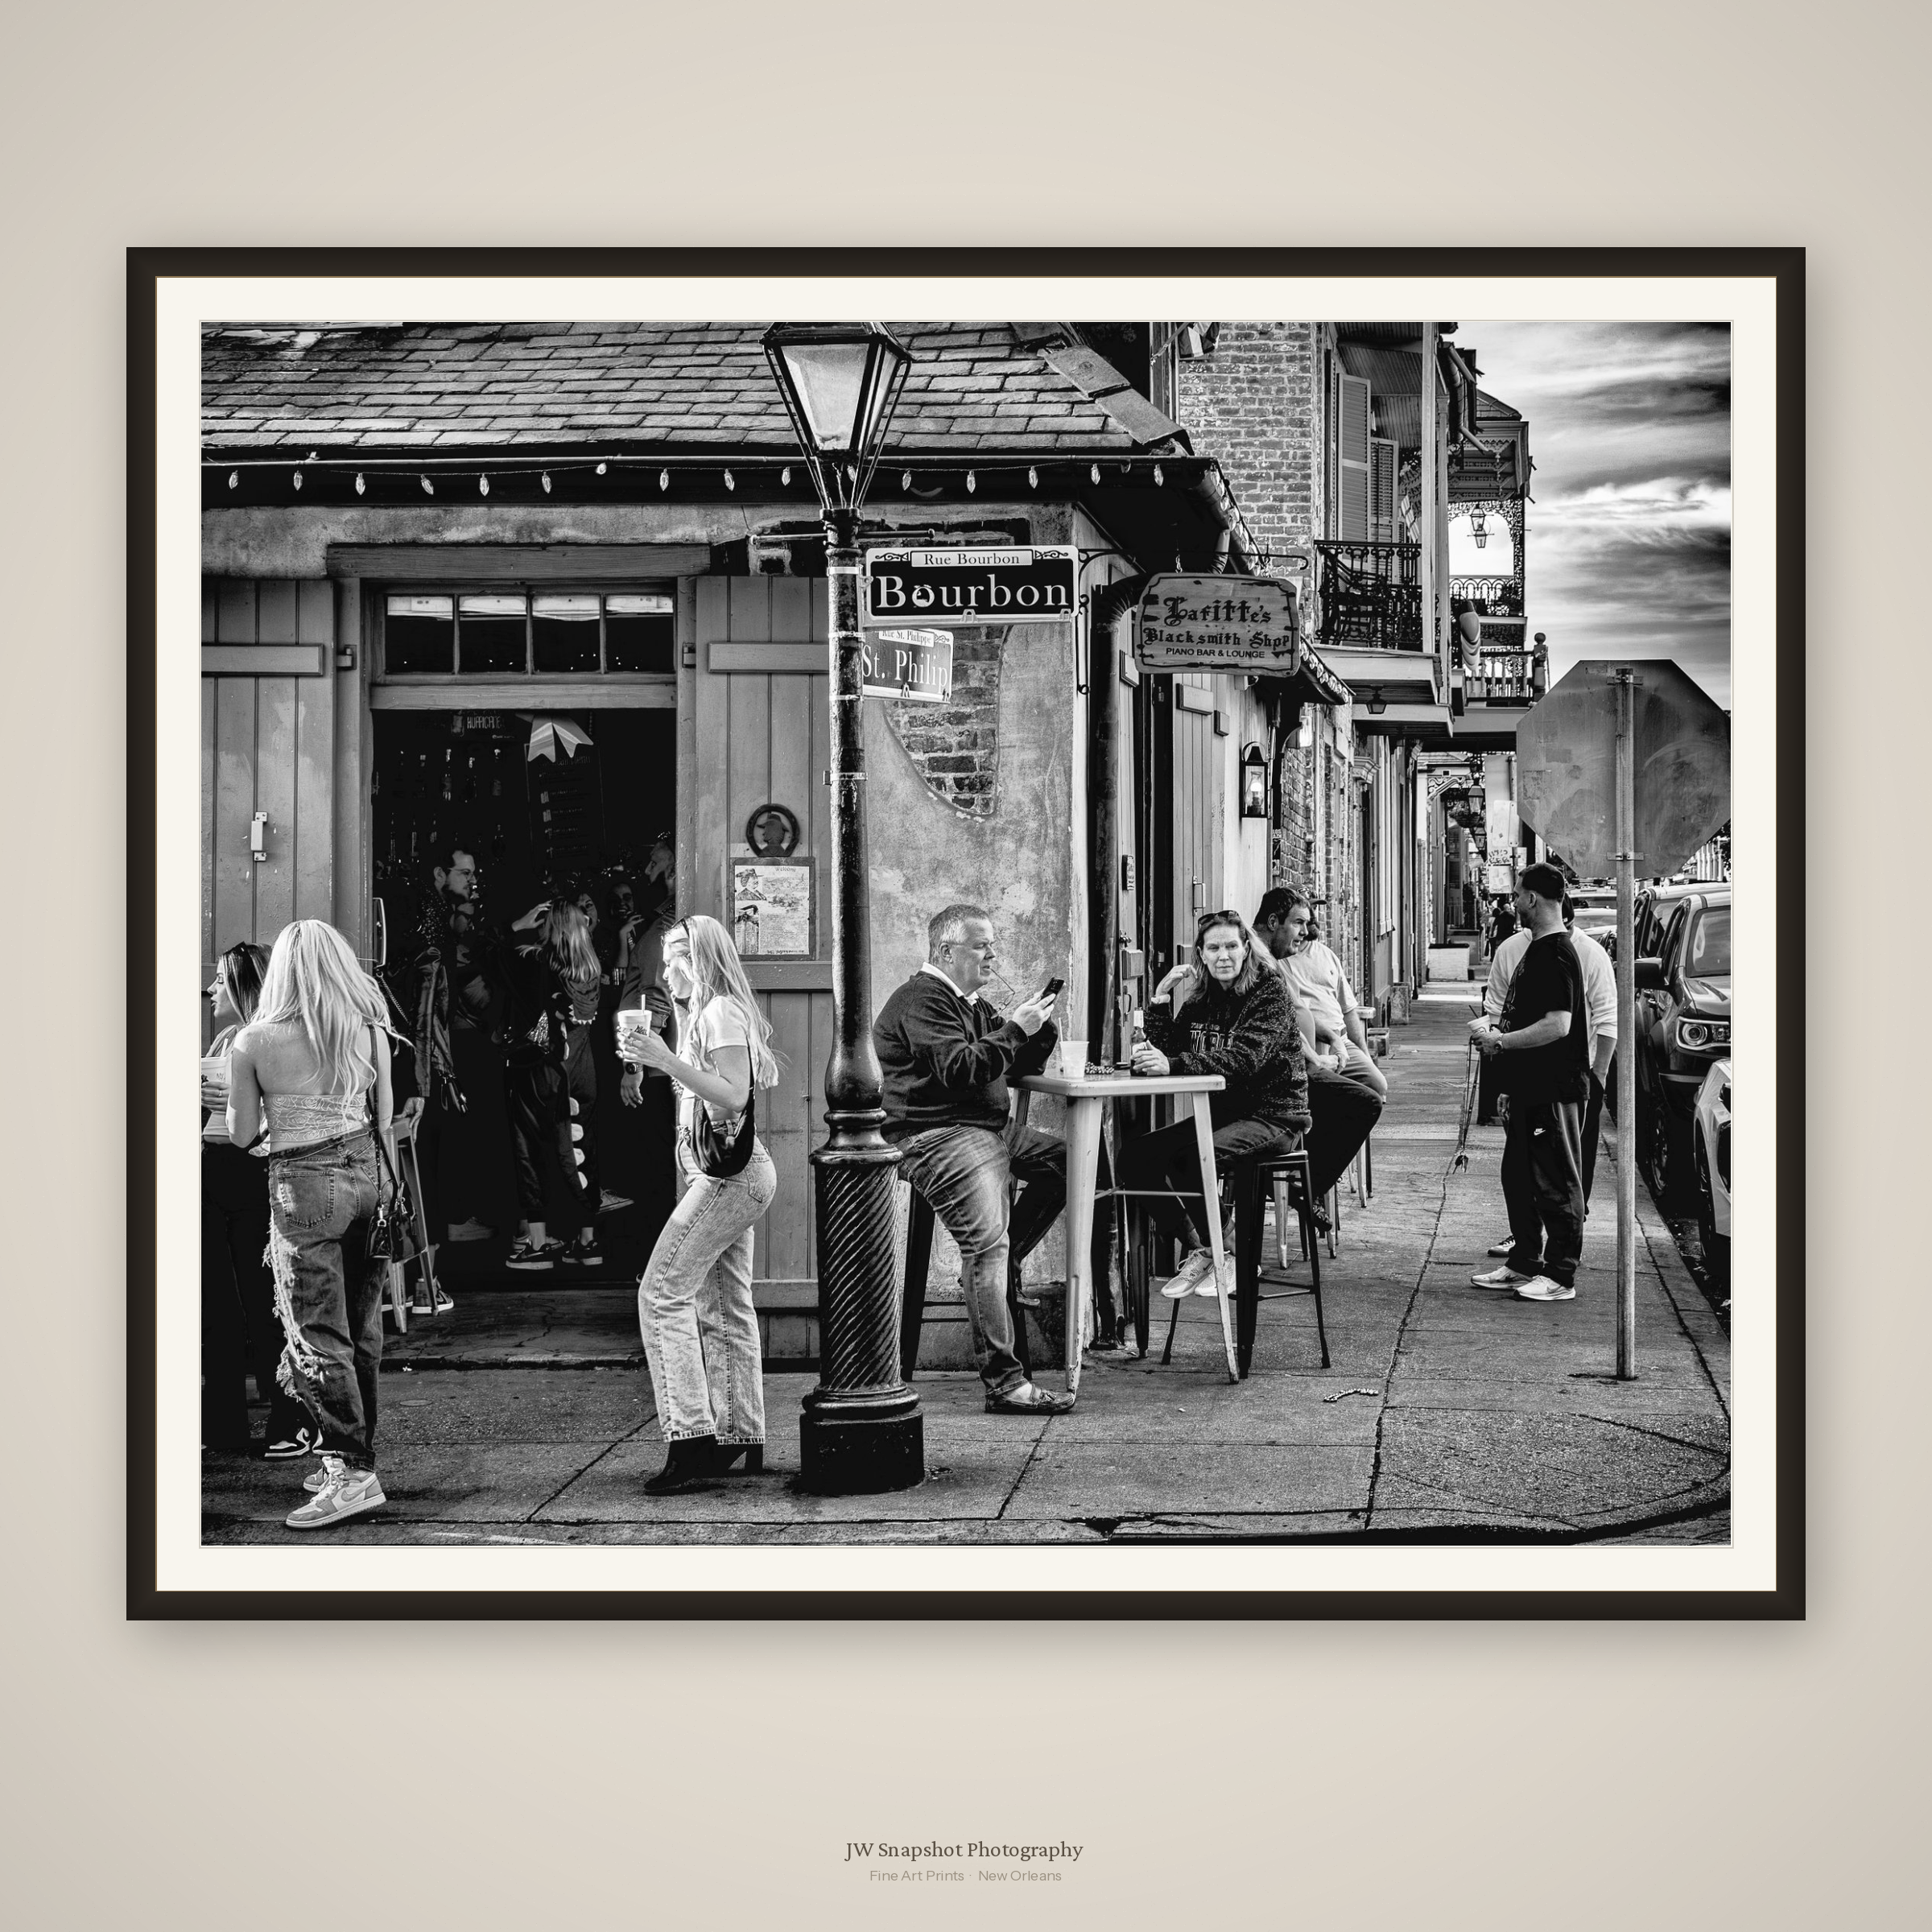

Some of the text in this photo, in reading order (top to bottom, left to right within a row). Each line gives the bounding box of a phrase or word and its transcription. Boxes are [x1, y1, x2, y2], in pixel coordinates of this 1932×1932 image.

[924, 552, 1020, 565] Rue Bourbon
[875, 573, 1069, 609] Bourbon
[1163, 596, 1272, 626] Lafitte's
[907, 630, 932, 646] Philippe
[1249, 630, 1290, 650] Shop
[1166, 647, 1265, 658] PIANO BAR & LOUNGE
[862, 645, 947, 694] St. Philip
